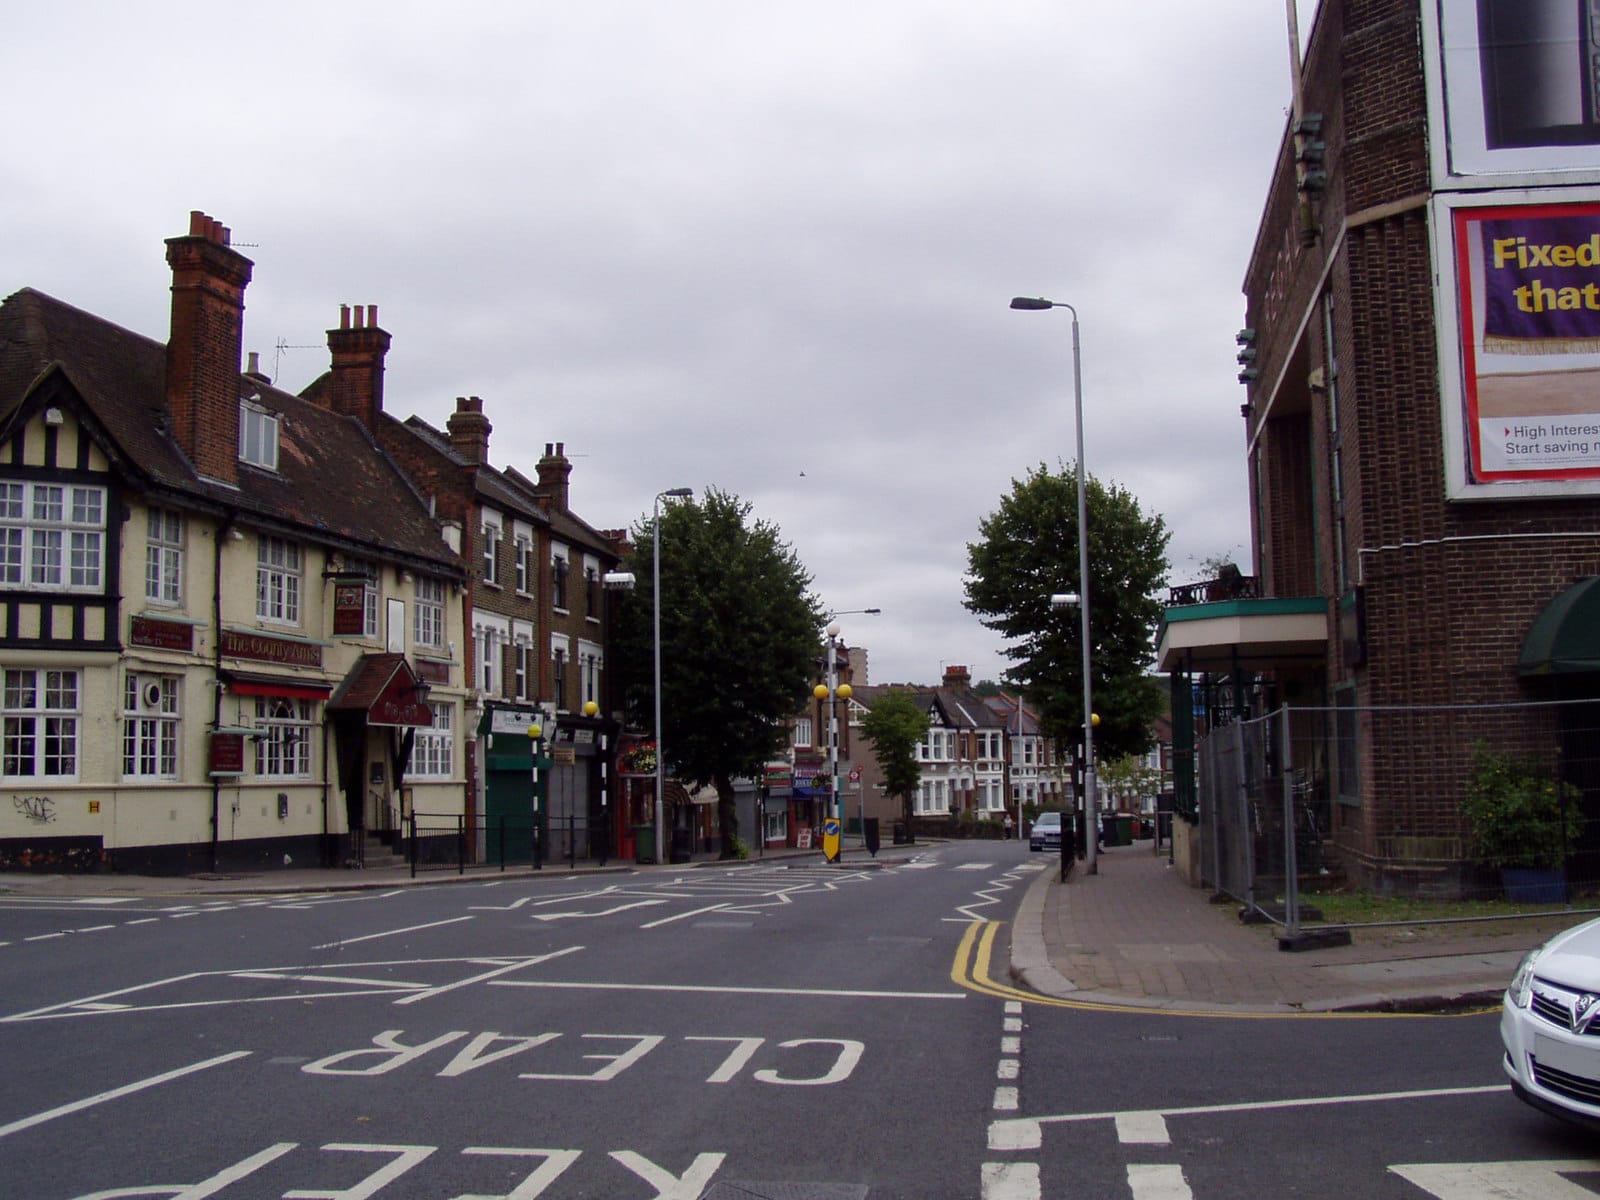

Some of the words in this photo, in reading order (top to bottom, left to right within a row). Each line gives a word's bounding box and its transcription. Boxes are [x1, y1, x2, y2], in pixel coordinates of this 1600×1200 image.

[1493, 233, 1600, 269] Fixed
[1512, 279, 1600, 313] that
[1514, 425, 1547, 440] High
[1551, 424, 1600, 437] Interes
[1505, 442, 1541, 455] Start
[1544, 440, 1589, 454] saving
[227, 632, 249, 652] The
[250, 638, 289, 661] County
[290, 645, 319, 662] Arms
[88, 801, 100, 813] H
[300, 1029, 866, 1086] CLEAR
